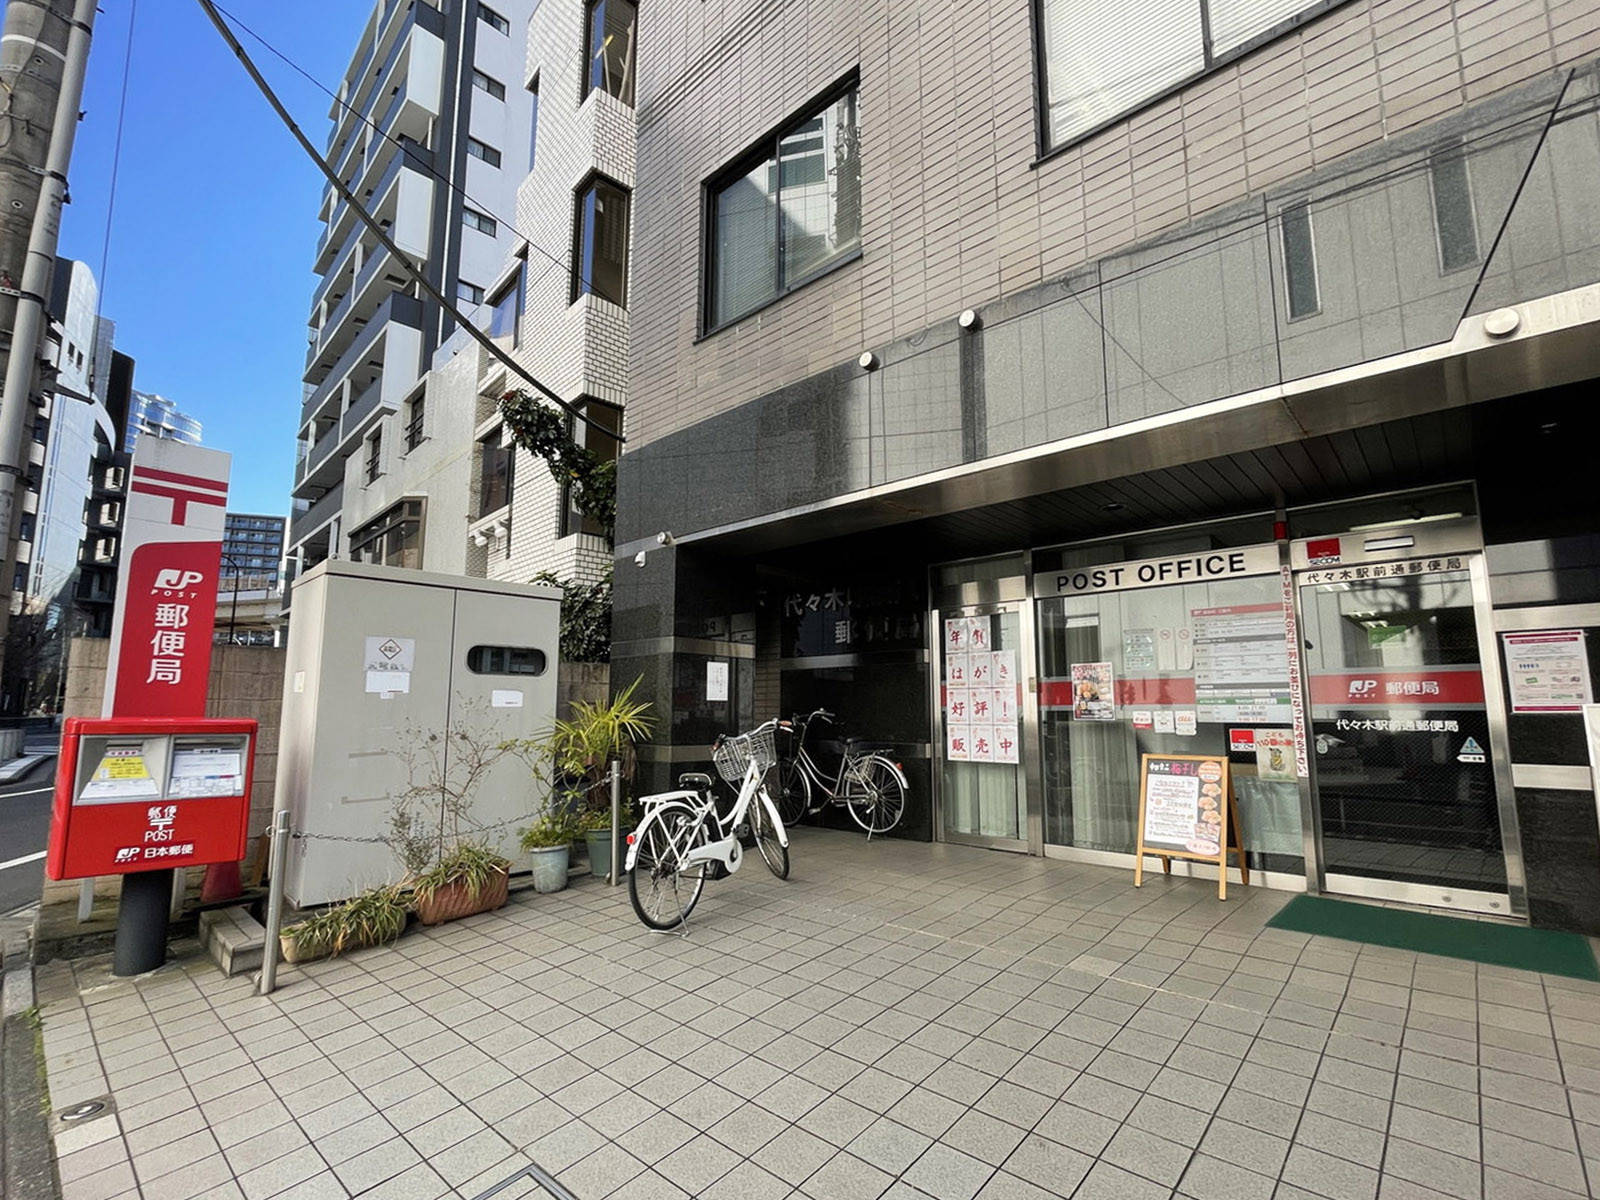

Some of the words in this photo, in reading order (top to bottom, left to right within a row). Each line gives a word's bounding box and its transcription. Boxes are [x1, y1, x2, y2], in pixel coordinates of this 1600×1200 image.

[1309, 556, 1341, 565] SECOM
[1056, 567, 1125, 592] POST
[1137, 552, 1246, 583] OFFICE
[1307, 557, 1462, 583] 代々木駅前通郵便局
[151, 589, 199, 600] POST
[147, 602, 191, 686] 郵便局
[951, 663, 1010, 680] はがき
[1385, 680, 1440, 696] 郵便局
[1336, 718, 1460, 733] 代々木駅前通郵便局
[951, 737, 1014, 756] 販売中
[147, 804, 178, 821] 郵便
[144, 828, 176, 843] POST
[144, 843, 194, 859] 日本郵便
